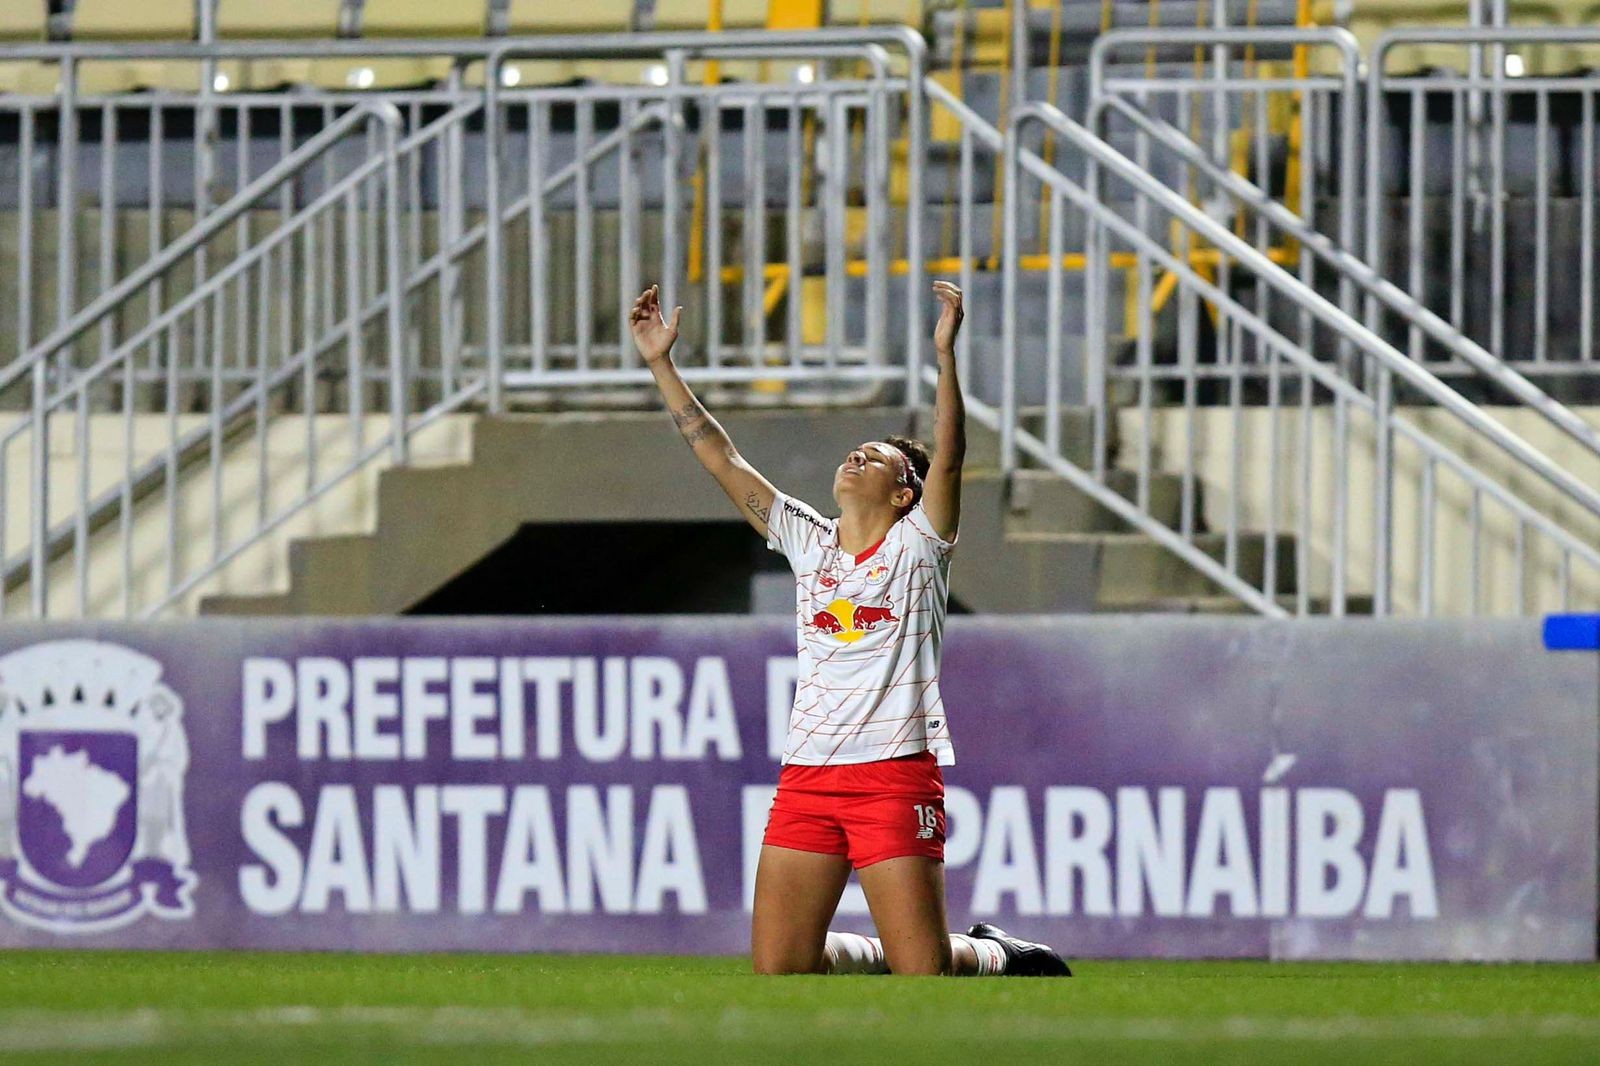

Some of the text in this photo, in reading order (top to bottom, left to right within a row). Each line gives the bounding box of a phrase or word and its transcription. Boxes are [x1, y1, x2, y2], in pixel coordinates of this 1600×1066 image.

[242, 656, 743, 761] PREFEITURA
[239, 781, 707, 915] SANTANA
[943, 754, 1439, 920] PARNAÍBA
[913, 804, 937, 828] 18
